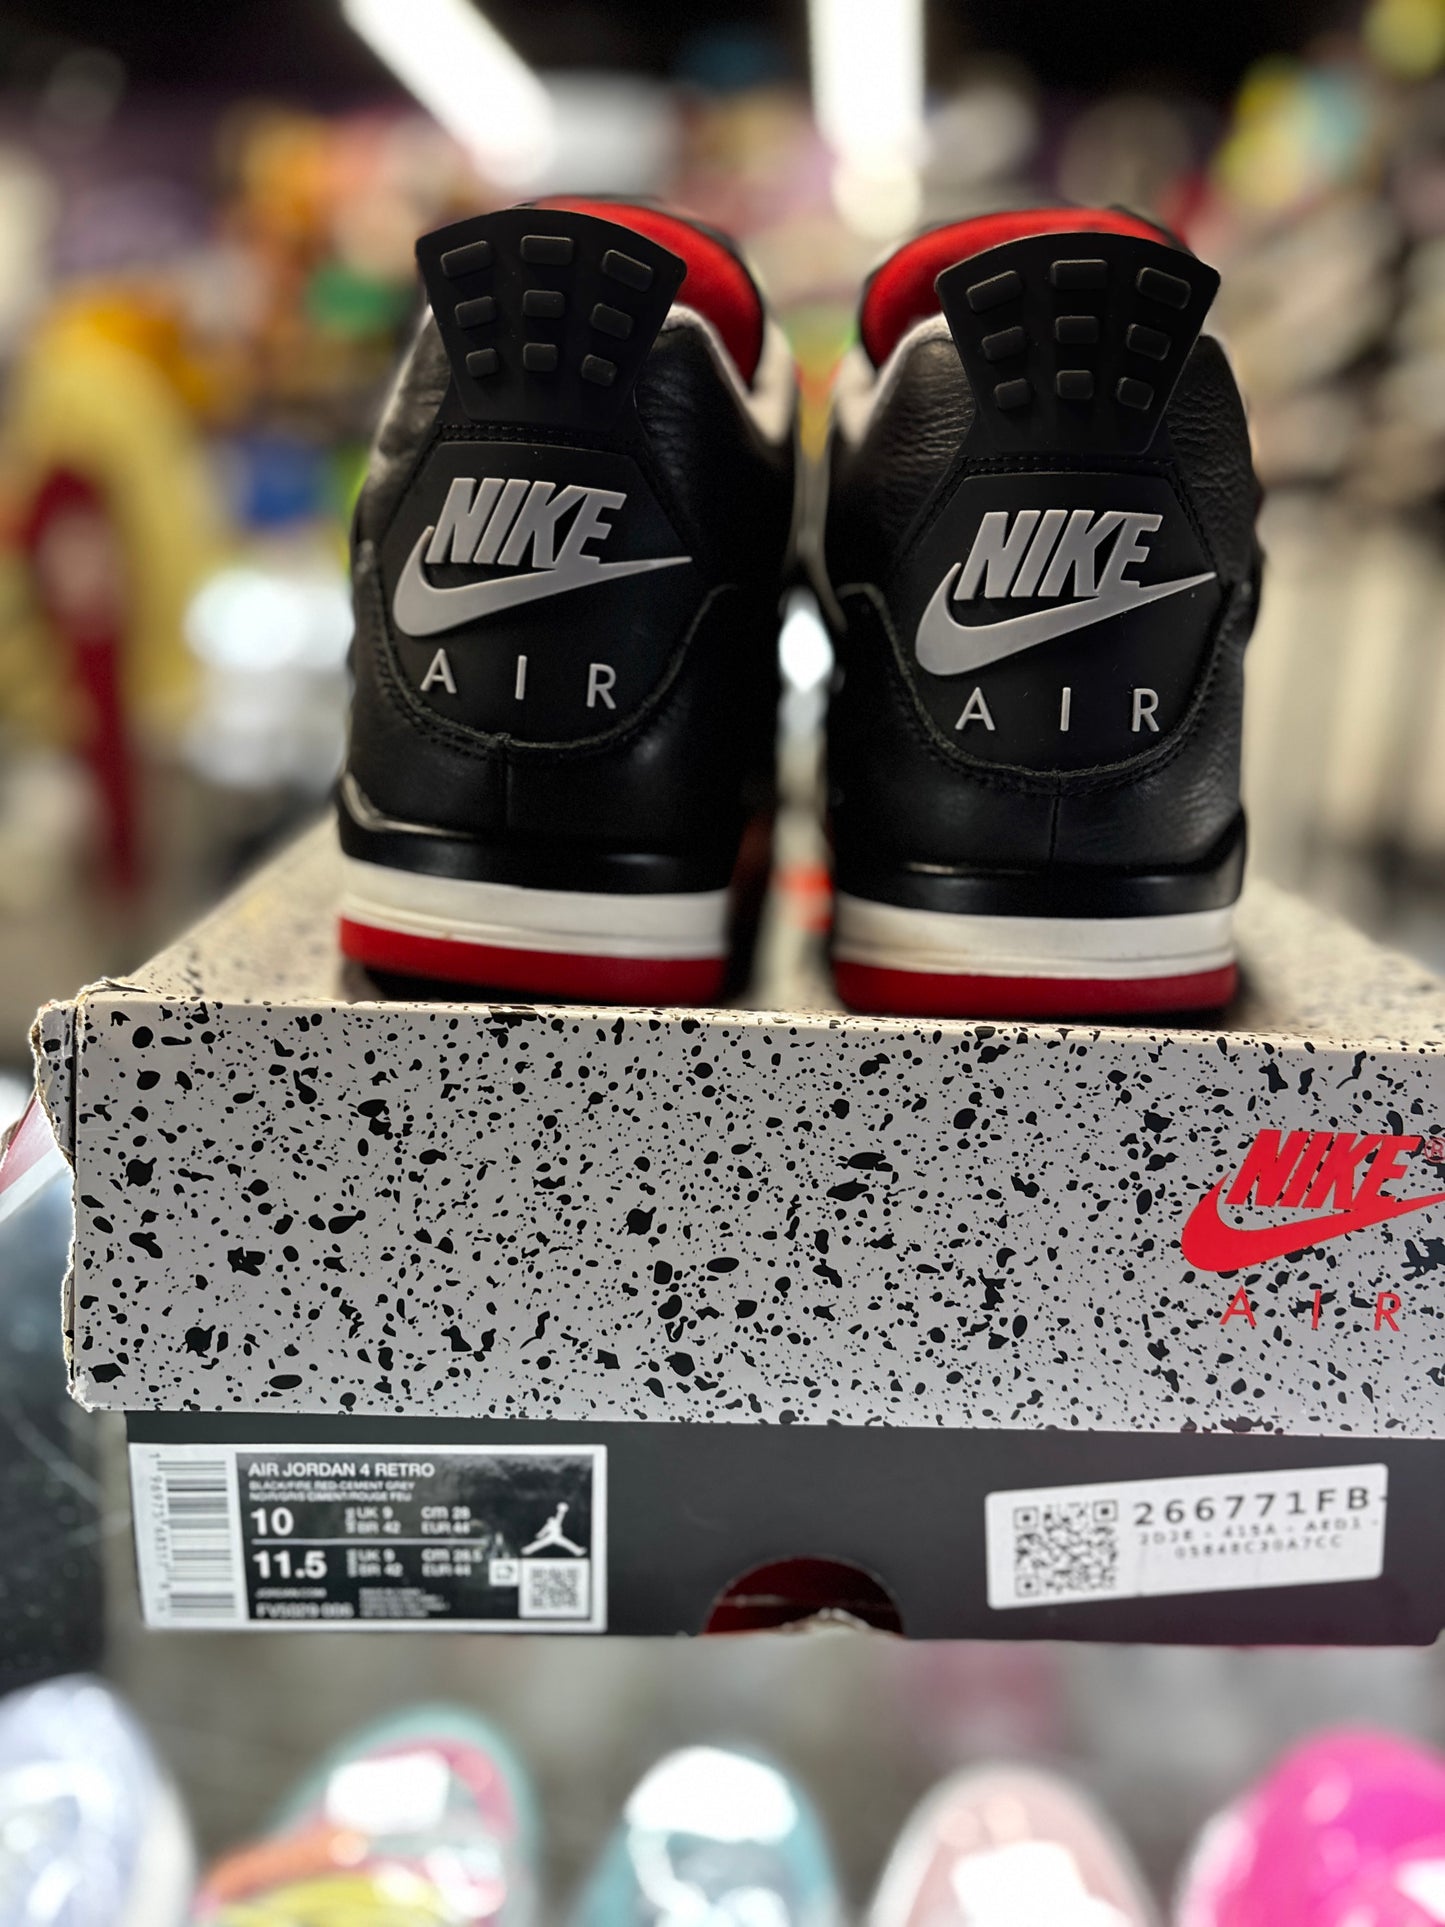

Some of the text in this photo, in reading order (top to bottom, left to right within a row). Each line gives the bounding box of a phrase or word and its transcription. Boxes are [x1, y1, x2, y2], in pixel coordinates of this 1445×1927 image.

[425, 478, 627, 569] NIKE
[954, 510, 1163, 600] NIKE
[420, 648, 617, 710] AIR
[955, 687, 1160, 732] AIR
[1225, 1129, 1423, 1209] NIKE
[1220, 1285, 1402, 1332] AIR
[248, 1462, 435, 1478] AIR JORDAN 4 RETRO
[385, 1480, 415, 1491] GREY
[250, 1507, 294, 1536] 10
[357, 1506, 379, 1520] UK
[382, 1506, 393, 1520] 9
[451, 1506, 471, 1520] 28
[382, 1520, 402, 1534] 42
[421, 1520, 451, 1534] EUR
[253, 1550, 328, 1579] 11.5
[358, 1549, 381, 1562] UK
[383, 1549, 396, 1562] 9
[421, 1563, 452, 1577] EUR
